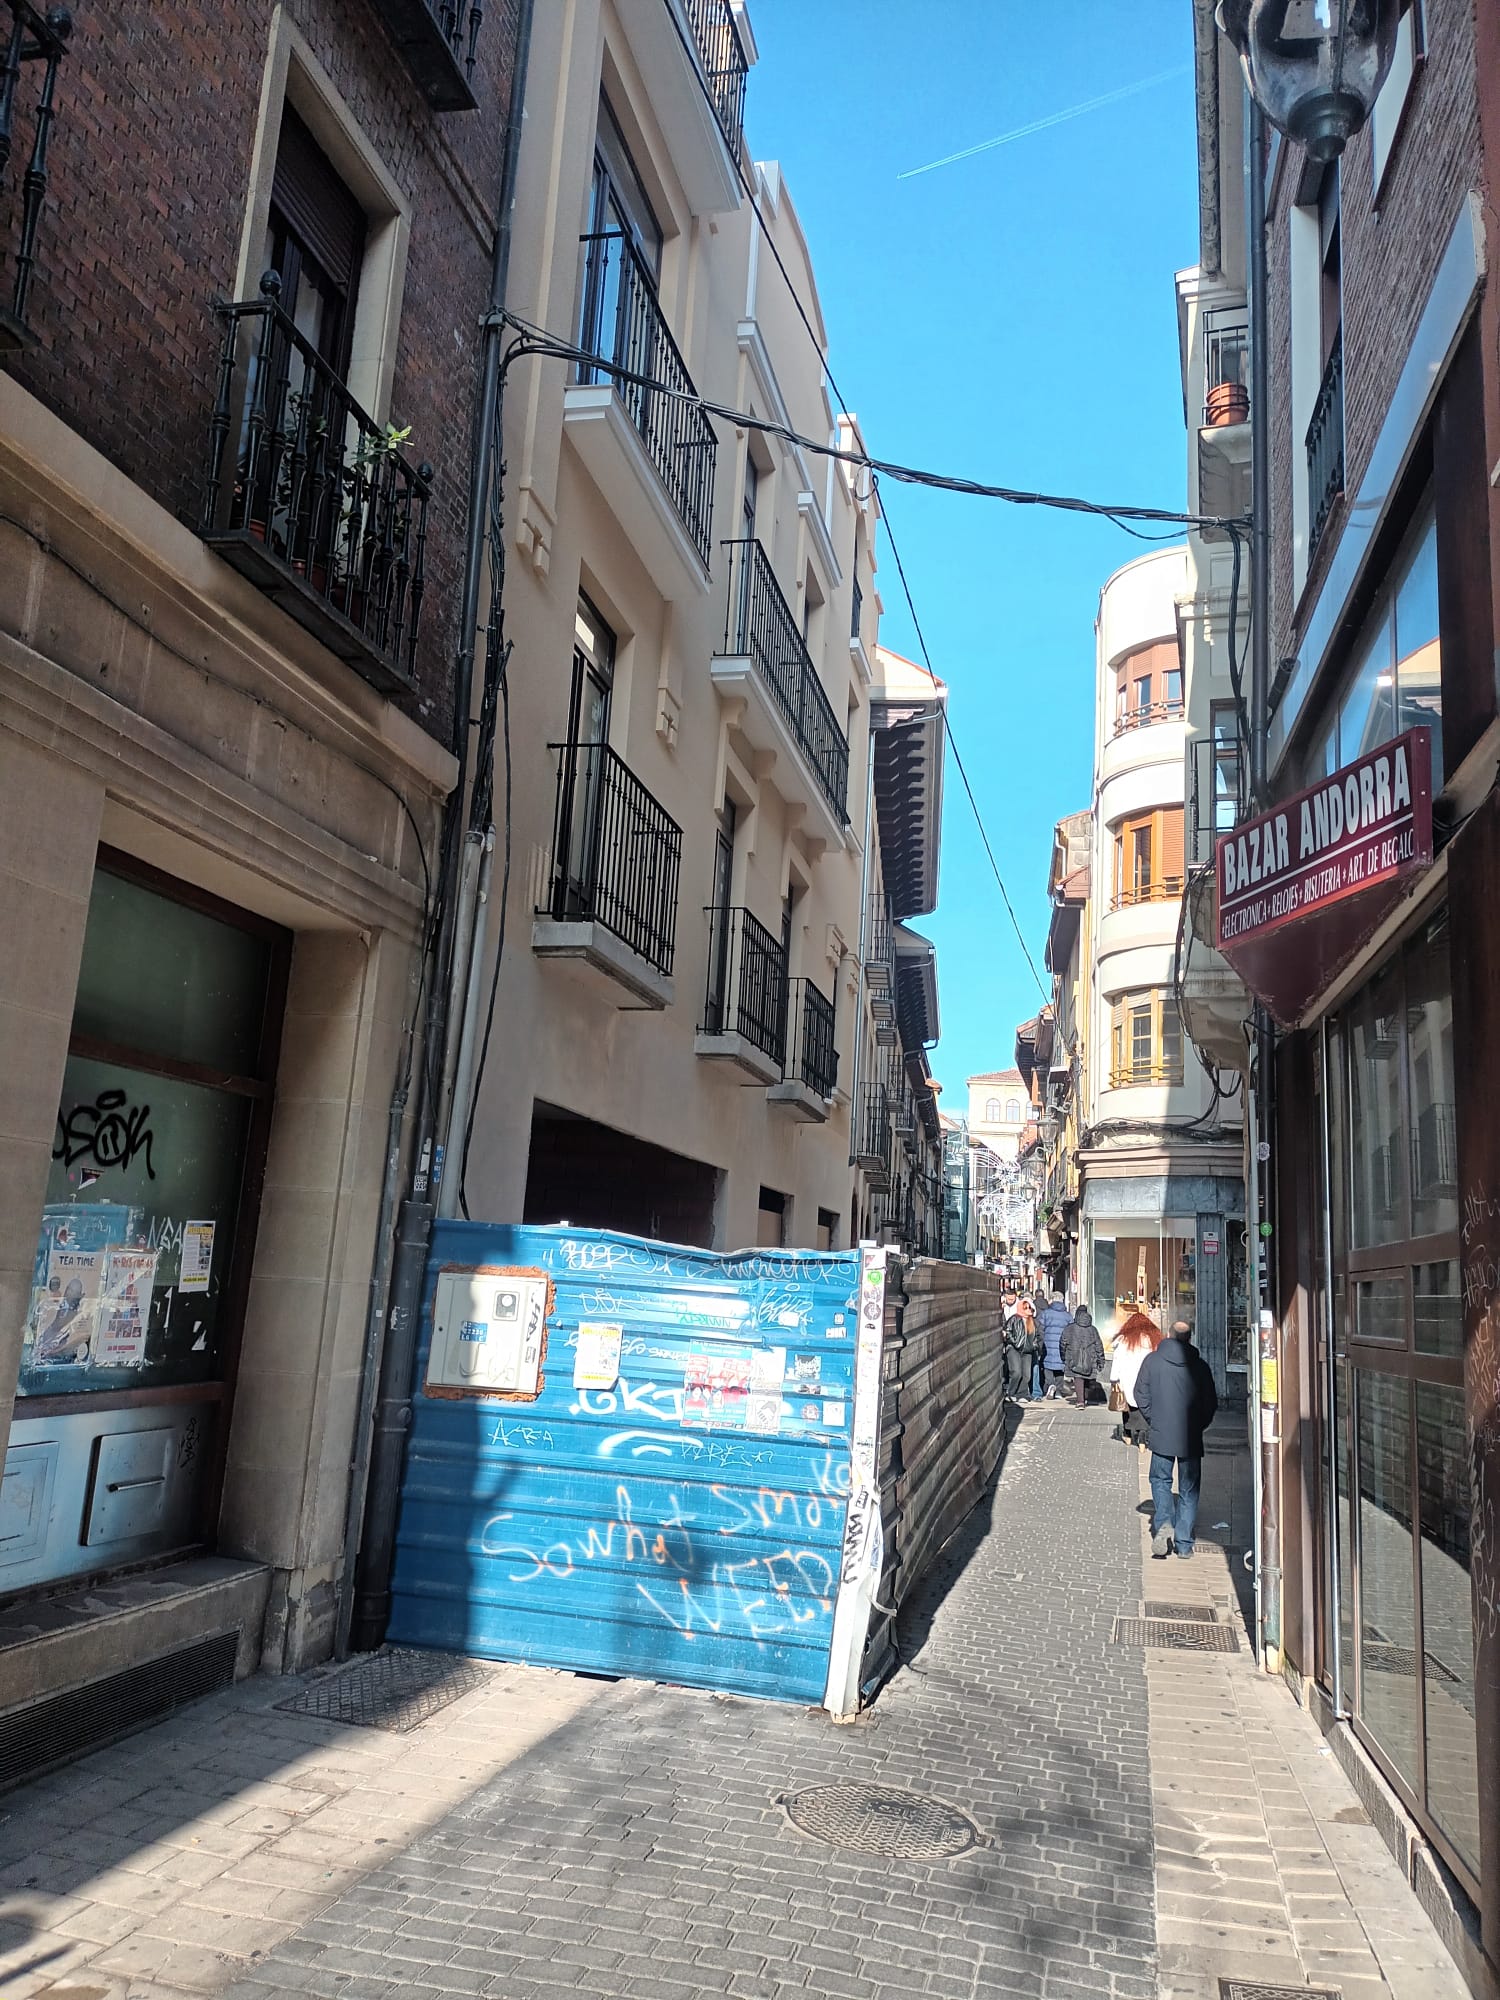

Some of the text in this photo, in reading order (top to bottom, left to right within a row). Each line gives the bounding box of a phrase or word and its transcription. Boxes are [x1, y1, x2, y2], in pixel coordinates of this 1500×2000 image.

[1224, 745, 1411, 896] BAZAR ANDORRA
[1223, 899, 1267, 939] ELECTRONICA
[1271, 883, 1299, 918] RELOJES
[1303, 863, 1341, 904] BISUTERIA
[1348, 852, 1365, 884] ART.
[1367, 846, 1379, 874] DE
[59, 1255, 95, 1267] TEA TIME
